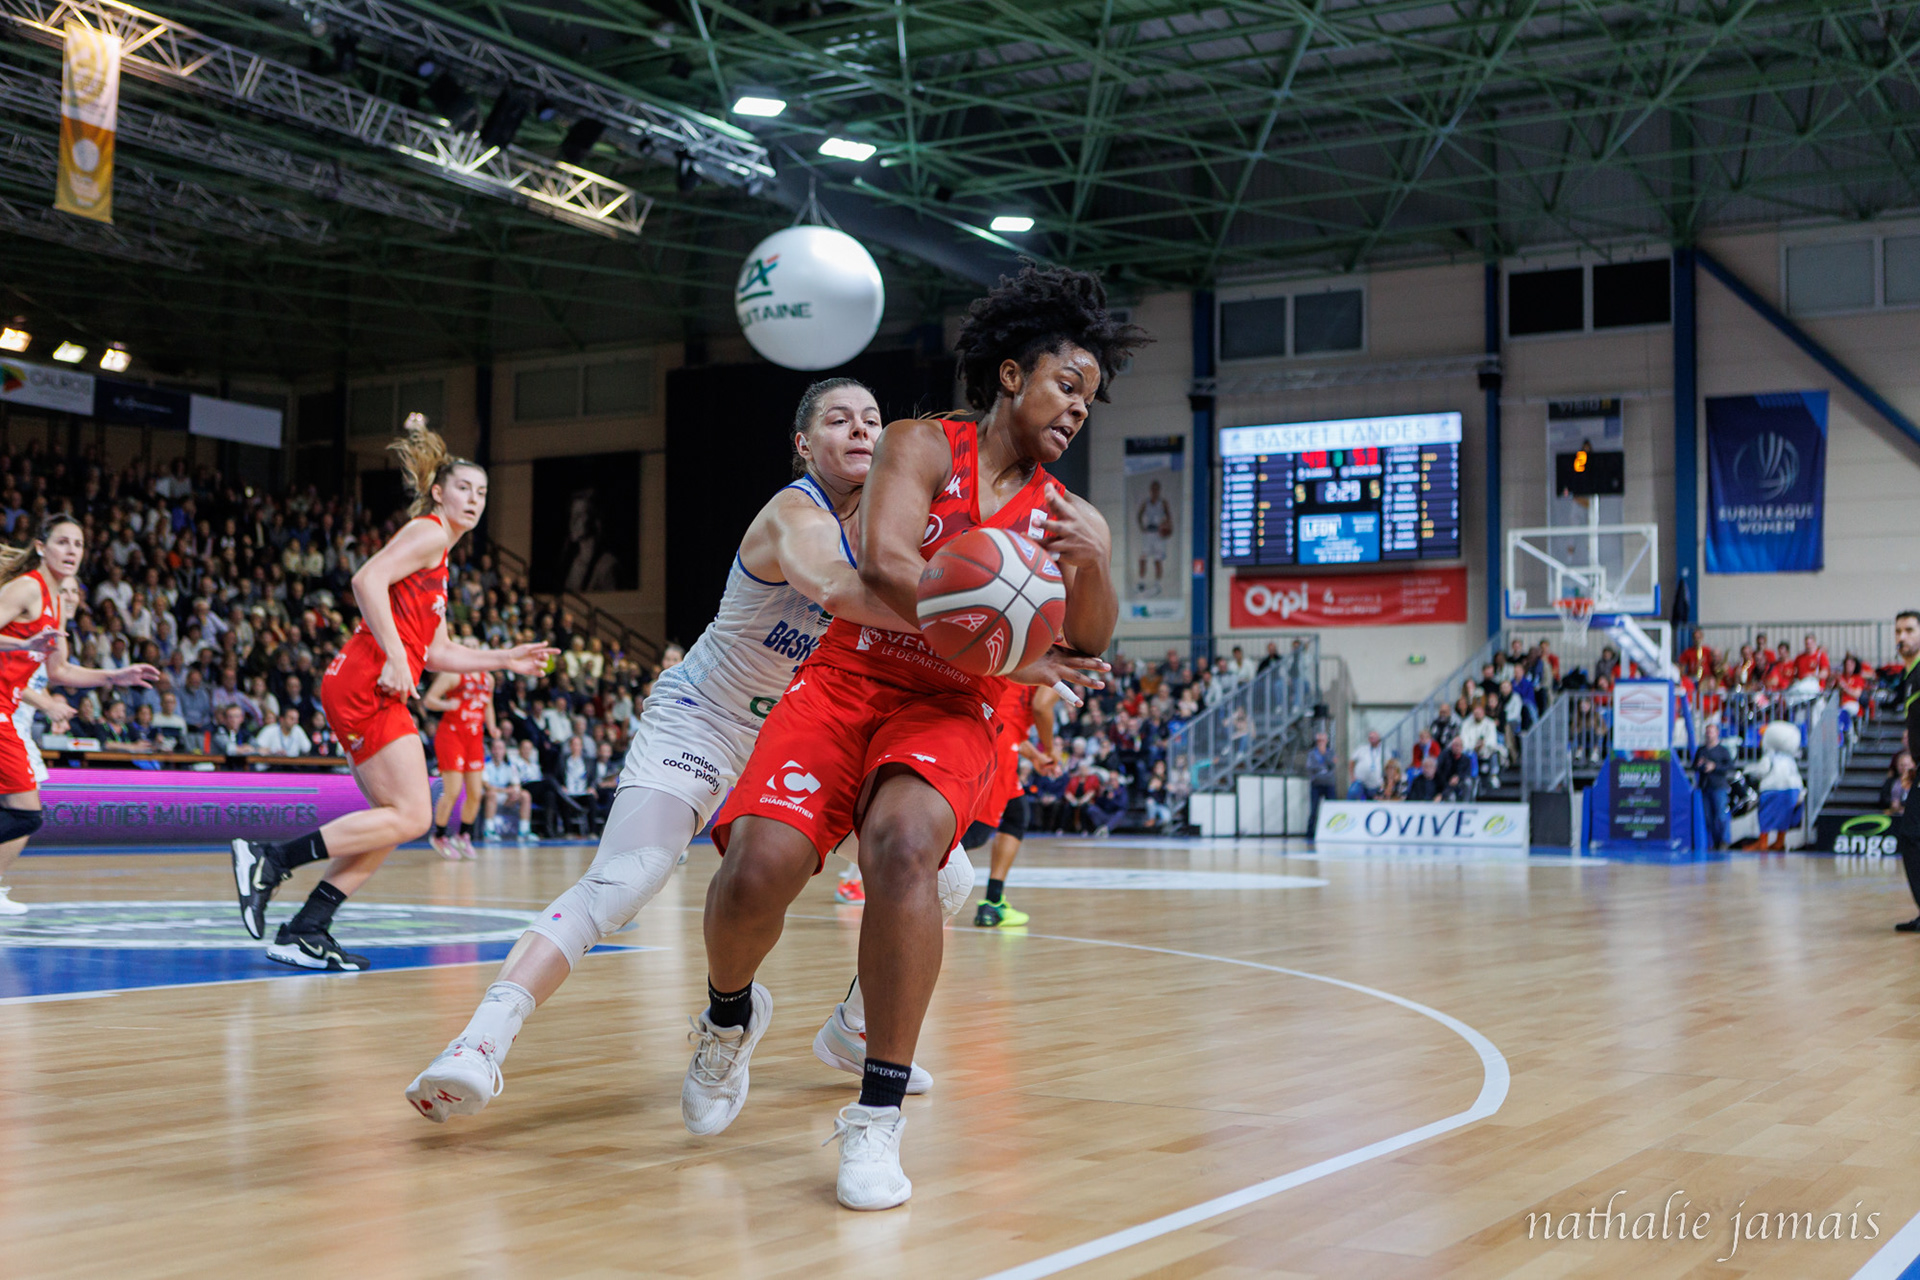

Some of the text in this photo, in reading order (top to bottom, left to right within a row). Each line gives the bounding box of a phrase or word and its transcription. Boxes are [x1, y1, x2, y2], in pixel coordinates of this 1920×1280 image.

[1254, 420, 1428, 448] BASKET LANDES
[1573, 450, 1588, 473] 2
[1718, 502, 1814, 521] EUROLEAGUE
[1737, 520, 1796, 534] WOMEN
[1244, 581, 1309, 620] Orpi
[763, 620, 820, 661] BASK
[886, 631, 942, 658] VEN
[881, 645, 972, 685] LE DÉPARTEMENT
[663, 758, 720, 791] coco-picoty
[681, 751, 720, 776] maison
[43, 801, 319, 826] ACYLITIES MULTI SERVICES
[759, 796, 815, 820] CHARPENTIER
[1833, 834, 1898, 858] ange
